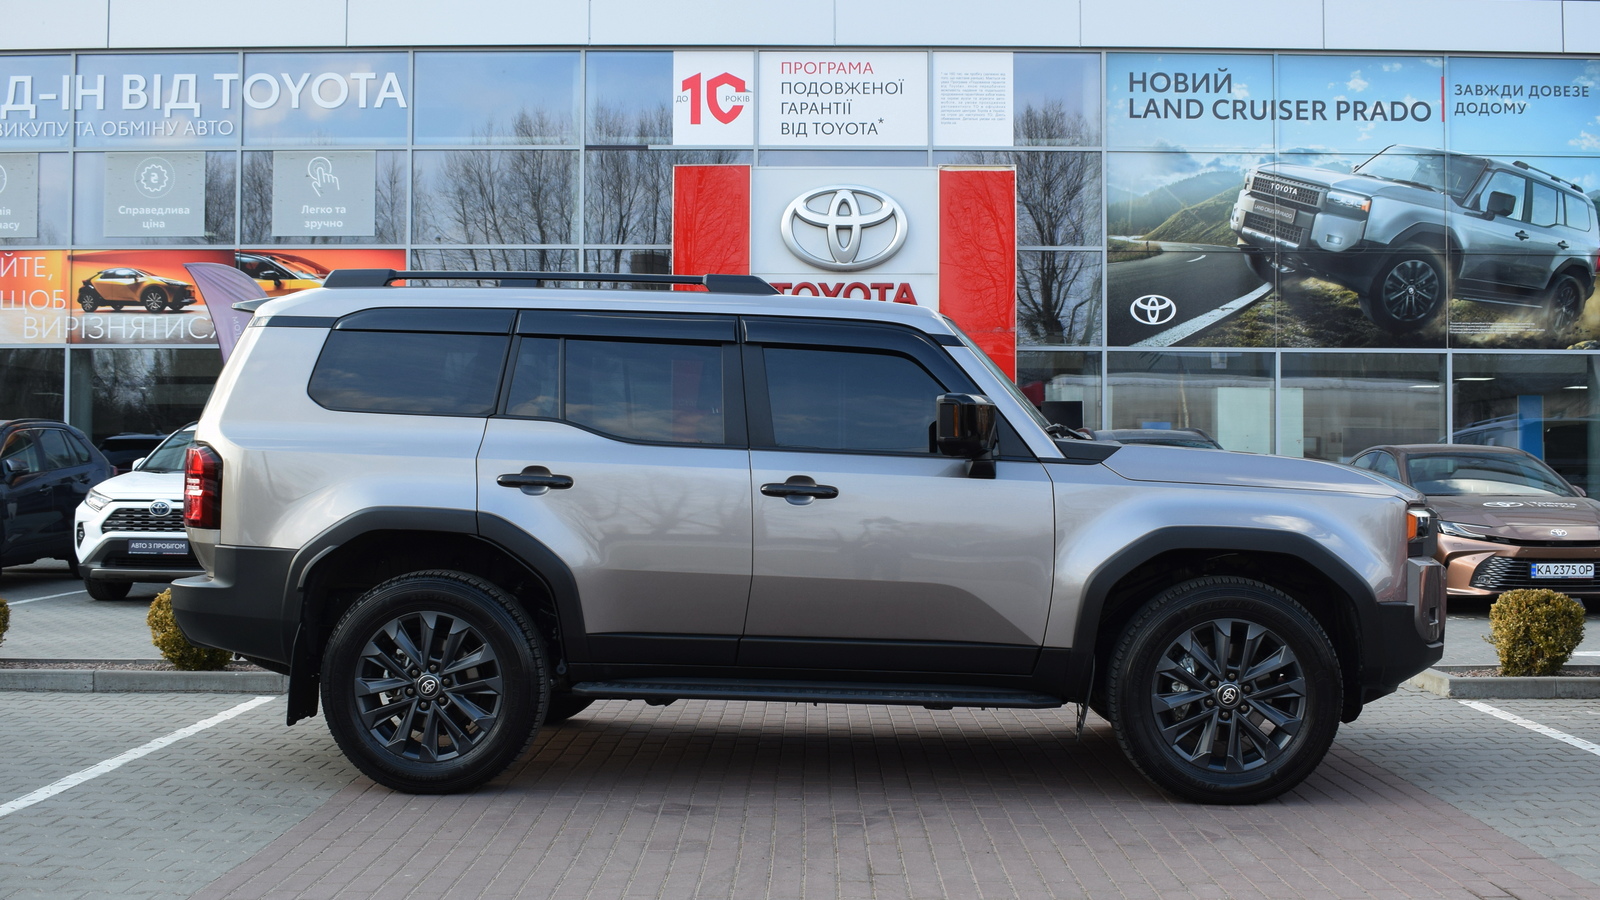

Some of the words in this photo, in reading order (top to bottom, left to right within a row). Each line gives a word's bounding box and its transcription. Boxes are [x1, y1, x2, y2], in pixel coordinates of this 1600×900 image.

[781, 61, 874, 75] ПРОГРАМА
[781, 79, 905, 97] ПОДОВЖЕНОЇ
[1129, 67, 1232, 94] НОВИЙ
[122, 73, 201, 118] ВІД
[213, 72, 408, 110] TOYOTA
[1454, 84, 1524, 98] ЗАВЖДИ
[1528, 86, 1590, 99] ДОВЕЗЕ
[676, 95, 689, 104] ДО
[725, 95, 750, 103] РОКІВ
[781, 99, 853, 115] ГАРАНТІЇ
[1129, 98, 1205, 119] LAND
[1212, 100, 1328, 121] CRUISER
[1336, 100, 1432, 122] PRADO
[1454, 102, 1527, 116] ДОДОМУ
[74, 121, 96, 136] ТА
[101, 120, 179, 136] ОБМІНУ
[184, 120, 234, 136] АВТО
[781, 122, 808, 137] ВІД
[1270, 182, 1297, 195] TOYOTA
[118, 205, 190, 216] Справедлива
[301, 204, 333, 216] Легко
[334, 205, 347, 215] та
[142, 219, 165, 229] ціна
[304, 219, 343, 230] зручно
[769, 282, 918, 305] TOYOTA
[0, 289, 67, 315] ЩОБ
[1553, 565, 1577, 575] 2375
